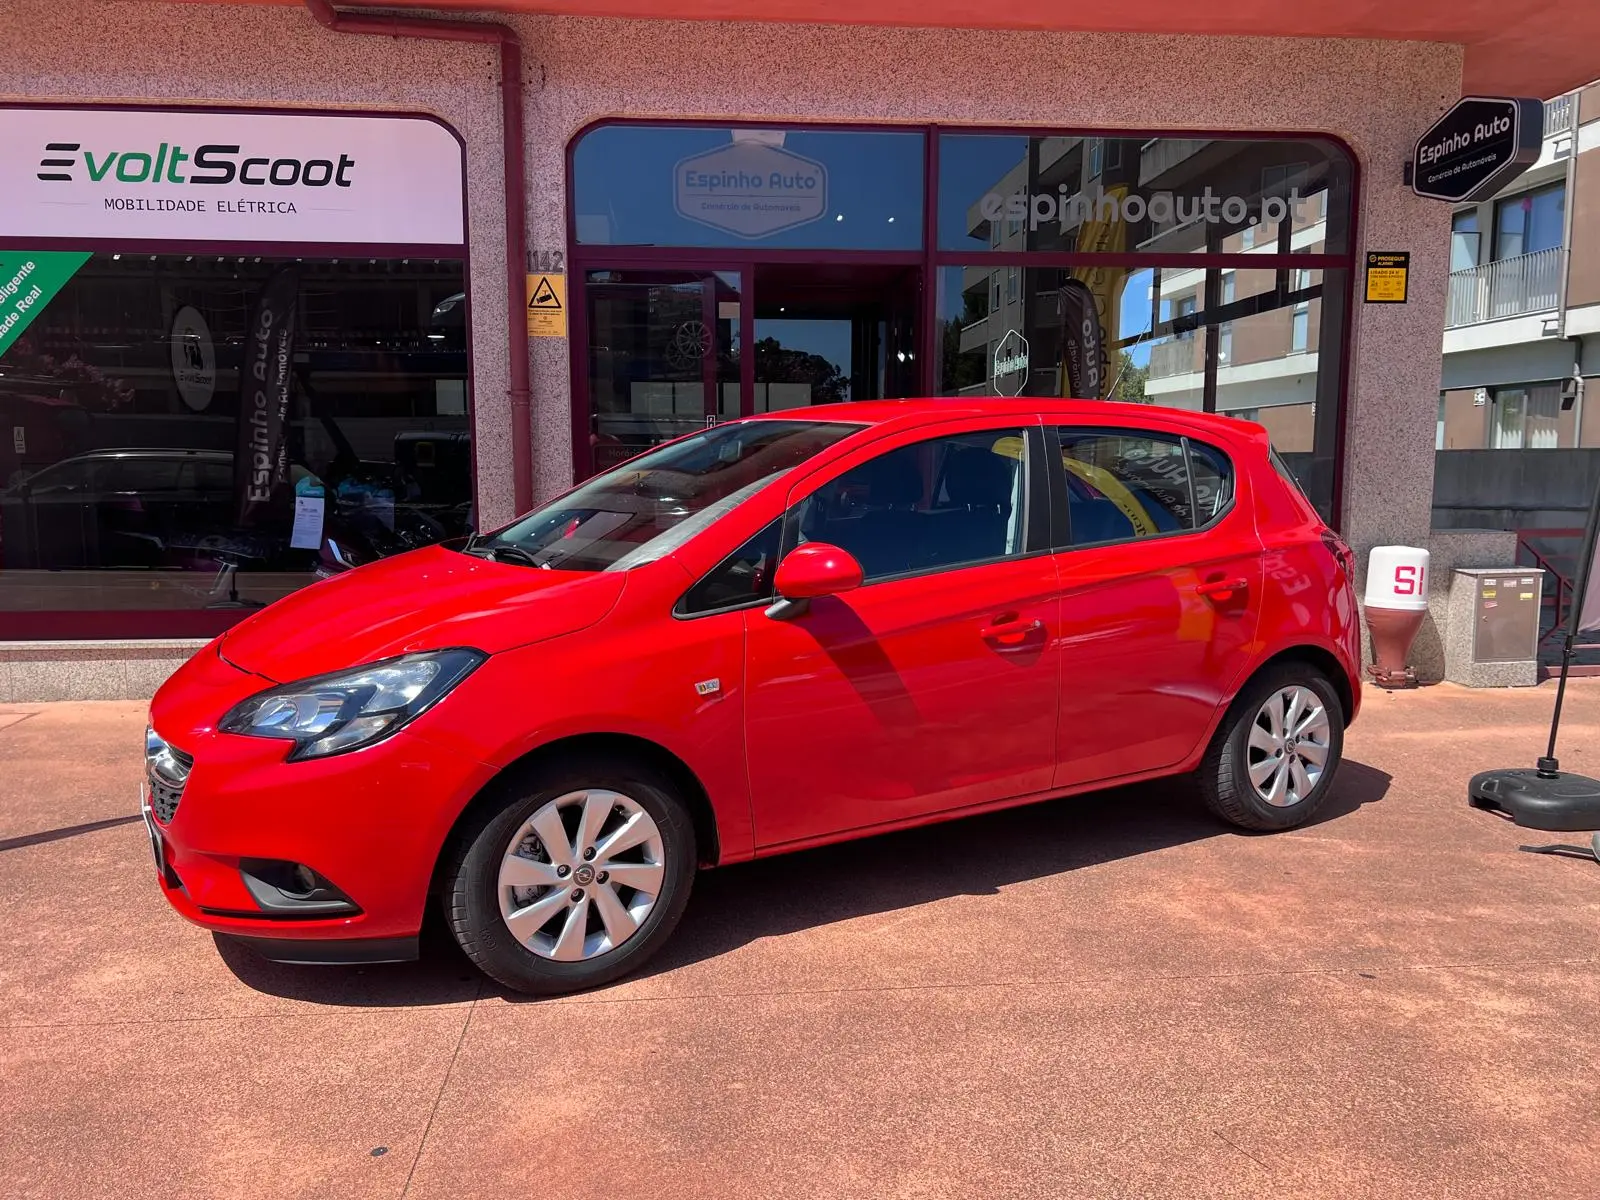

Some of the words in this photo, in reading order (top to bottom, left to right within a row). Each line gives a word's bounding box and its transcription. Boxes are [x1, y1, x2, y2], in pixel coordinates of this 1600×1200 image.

[1419, 131, 1471, 165] Espinho
[1473, 115, 1511, 143] Auto
[37, 142, 355, 187] EvoltScoot
[685, 170, 763, 192] Espinho
[769, 172, 816, 190] Auto
[1427, 167, 1453, 184] Comércio
[1453, 165, 1461, 174] de
[1461, 152, 1497, 171] Automóveis
[104, 198, 206, 212] MOBILIDADE
[217, 198, 297, 214] ELÉTRICA
[980, 184, 1307, 232] espinhoauto.pt
[527, 250, 564, 273] 1142
[15, 284, 43, 313] Real
[253, 309, 273, 381] Auto
[247, 390, 273, 502] Espinho
